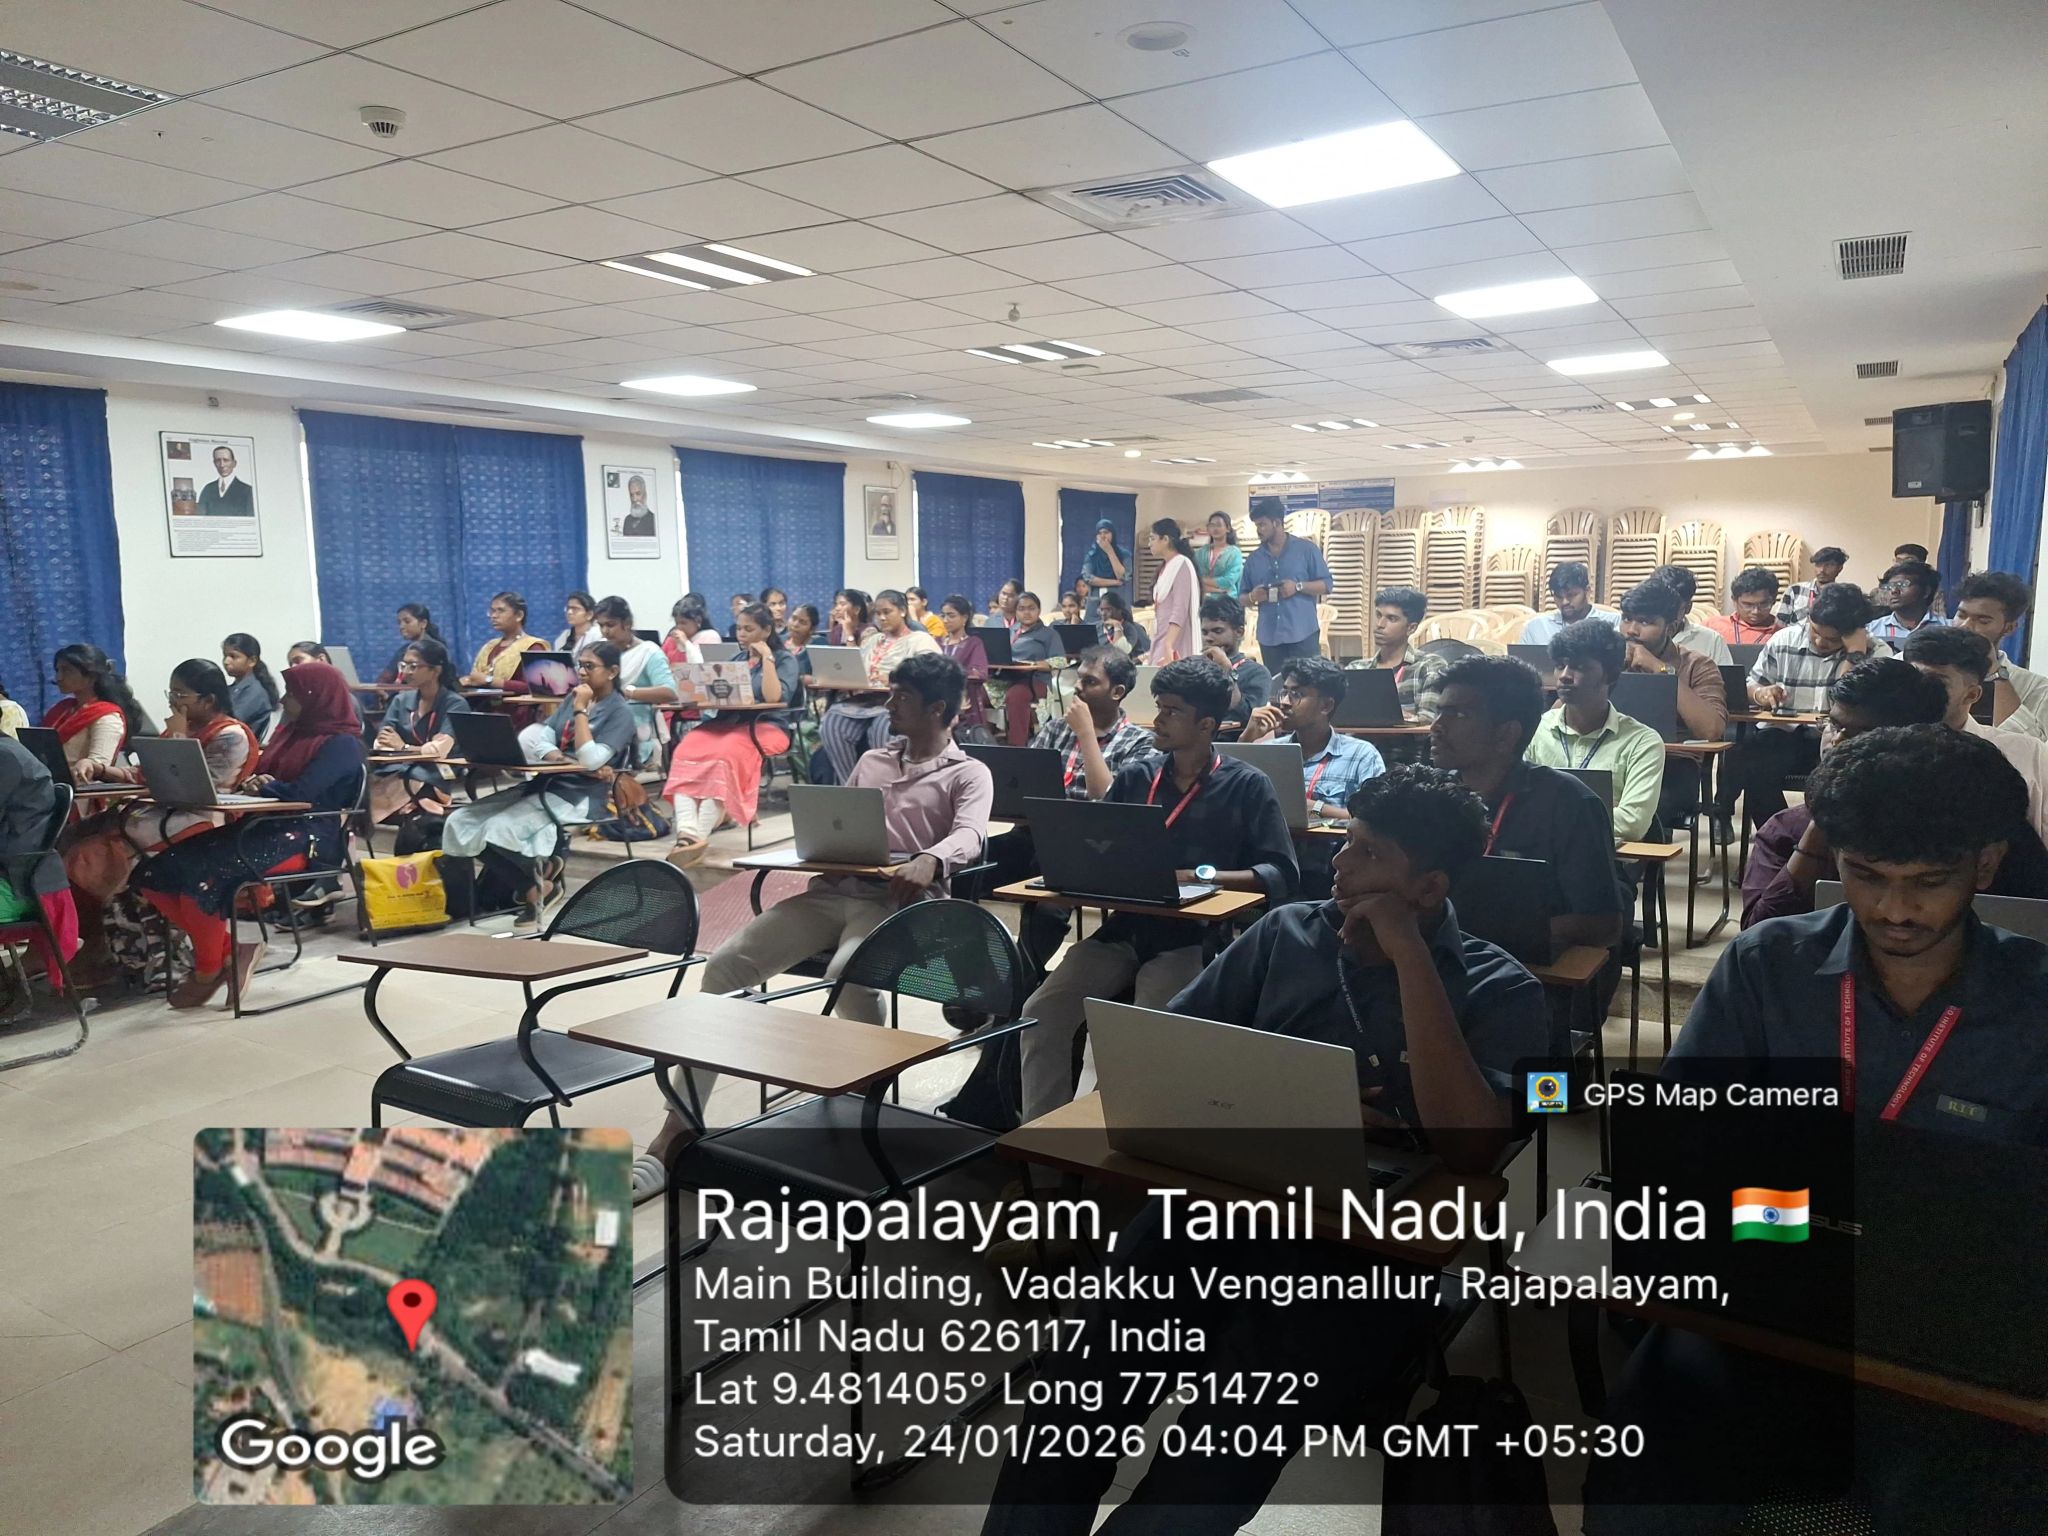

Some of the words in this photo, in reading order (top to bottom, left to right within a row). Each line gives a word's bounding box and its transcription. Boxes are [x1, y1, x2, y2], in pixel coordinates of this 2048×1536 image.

[1926, 1016, 1951, 1052] INSTITUTE
[1890, 1063, 1921, 1108] TECHNOLOGY
[1809, 1213, 1863, 1236] SUS
